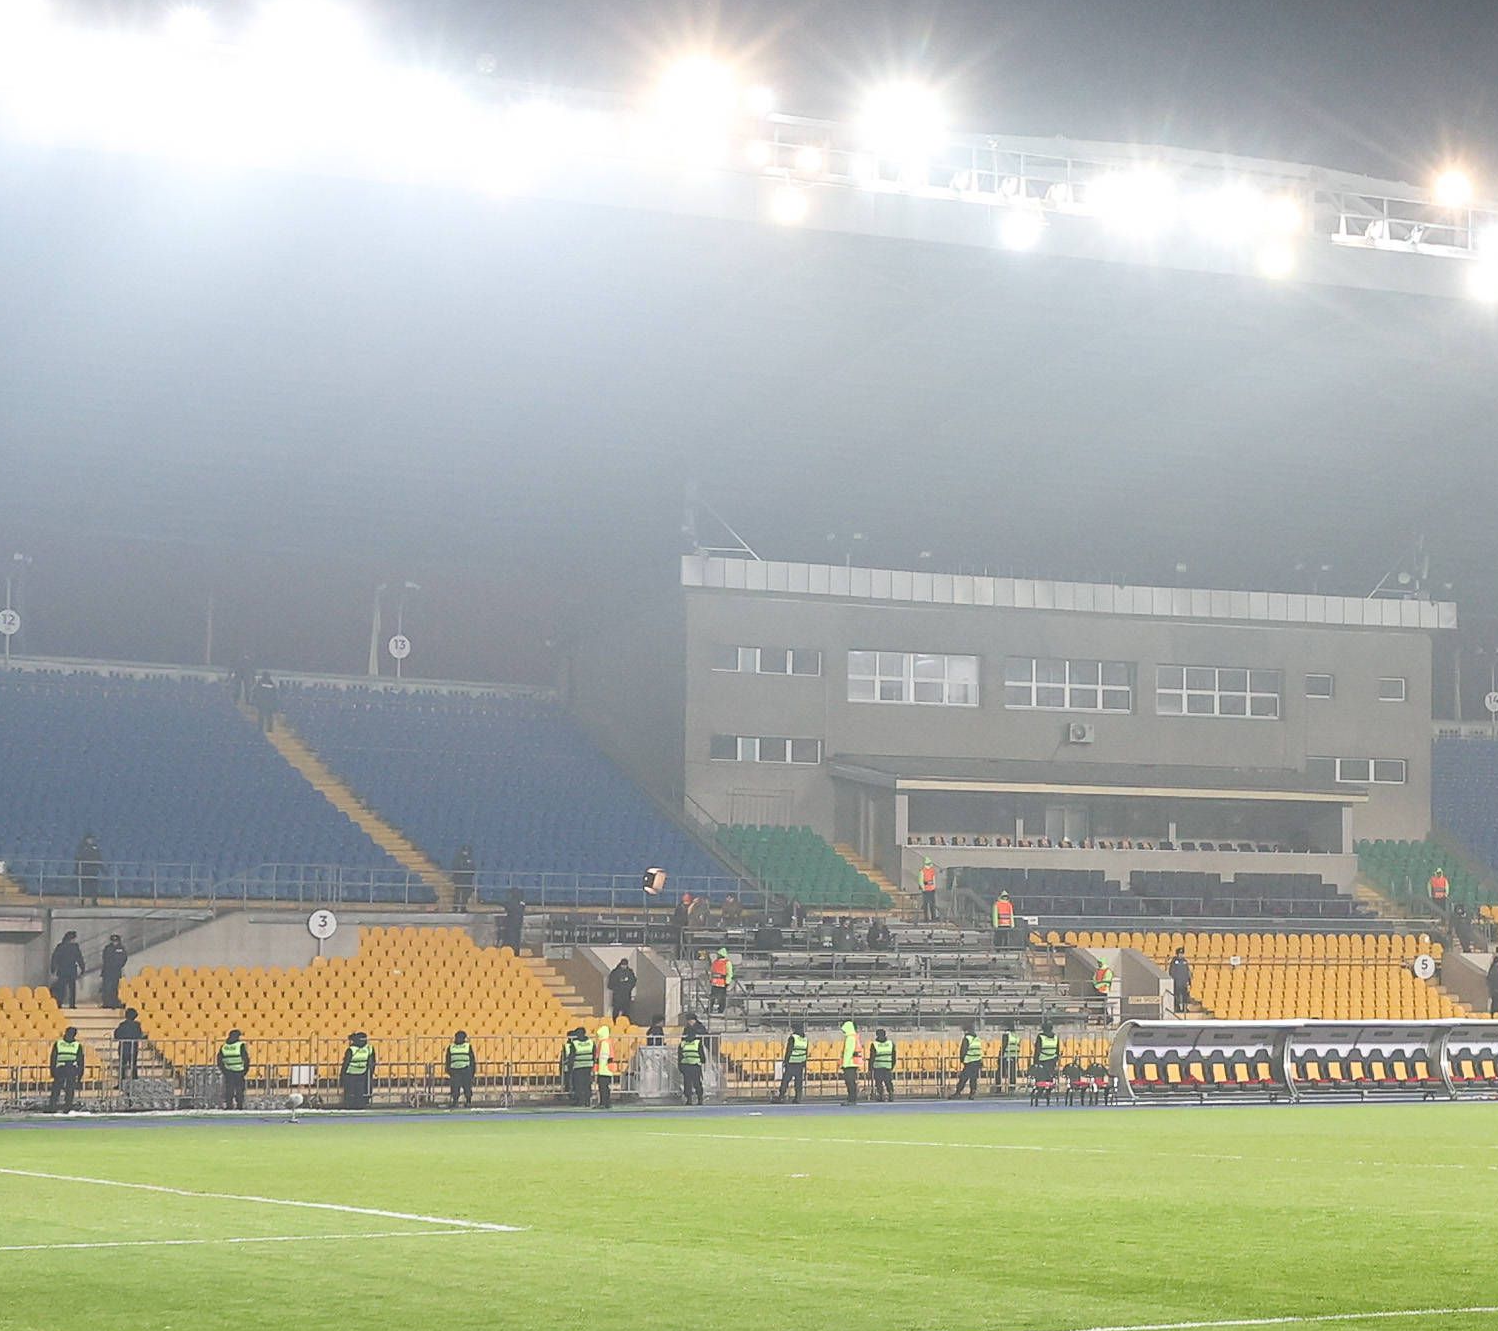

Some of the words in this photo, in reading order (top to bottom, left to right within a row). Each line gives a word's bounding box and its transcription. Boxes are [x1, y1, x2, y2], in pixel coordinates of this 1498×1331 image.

[2, 614, 15, 625] 12
[393, 639, 406, 650] 13
[317, 915, 328, 928] 3
[1421, 959, 1428, 970] 5
